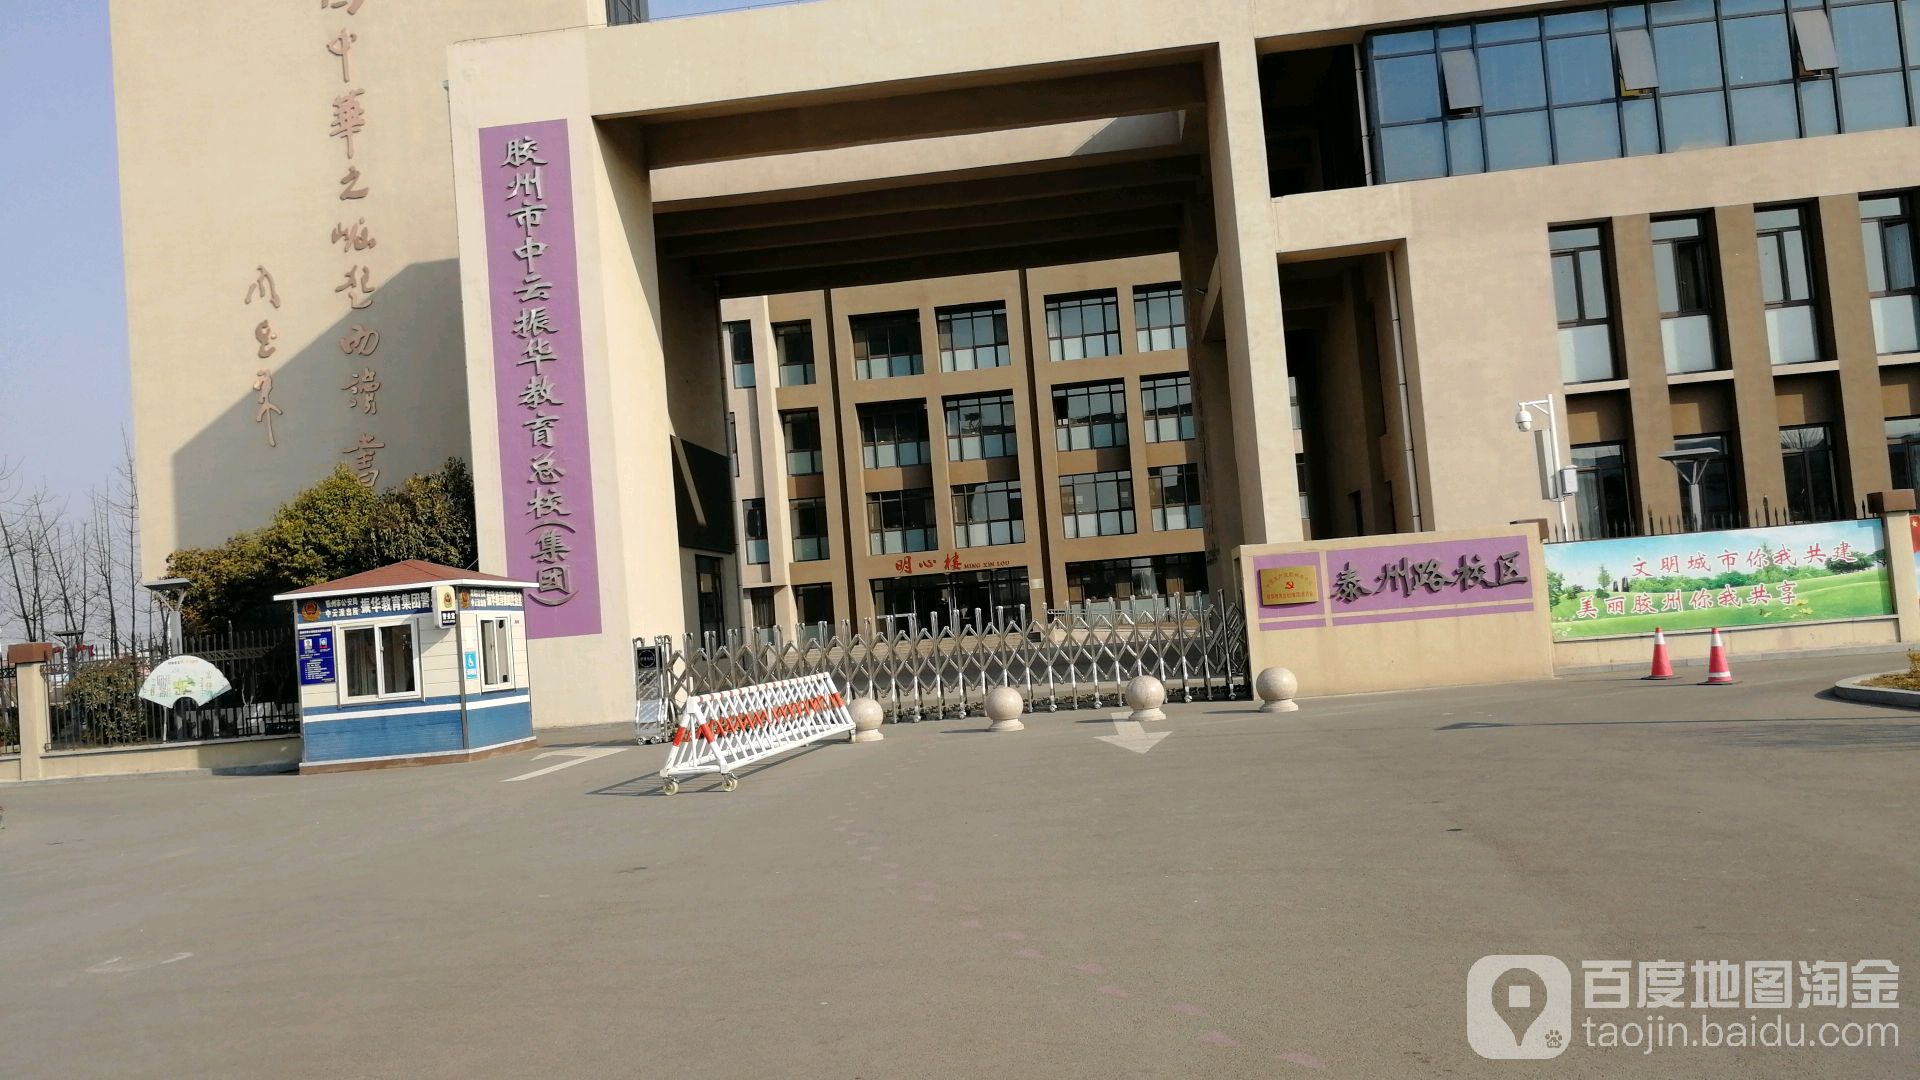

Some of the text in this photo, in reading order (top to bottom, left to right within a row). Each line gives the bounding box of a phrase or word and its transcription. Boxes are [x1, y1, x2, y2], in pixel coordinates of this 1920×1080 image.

[895, 552, 962, 574] 明心楼
[1329, 551, 1529, 604] 泰州路校区
[1632, 540, 1858, 578] 文明城市你我共建
[360, 592, 433, 614] 振华教育集团警
[1576, 580, 1798, 619] 美丽胶州你我共享
